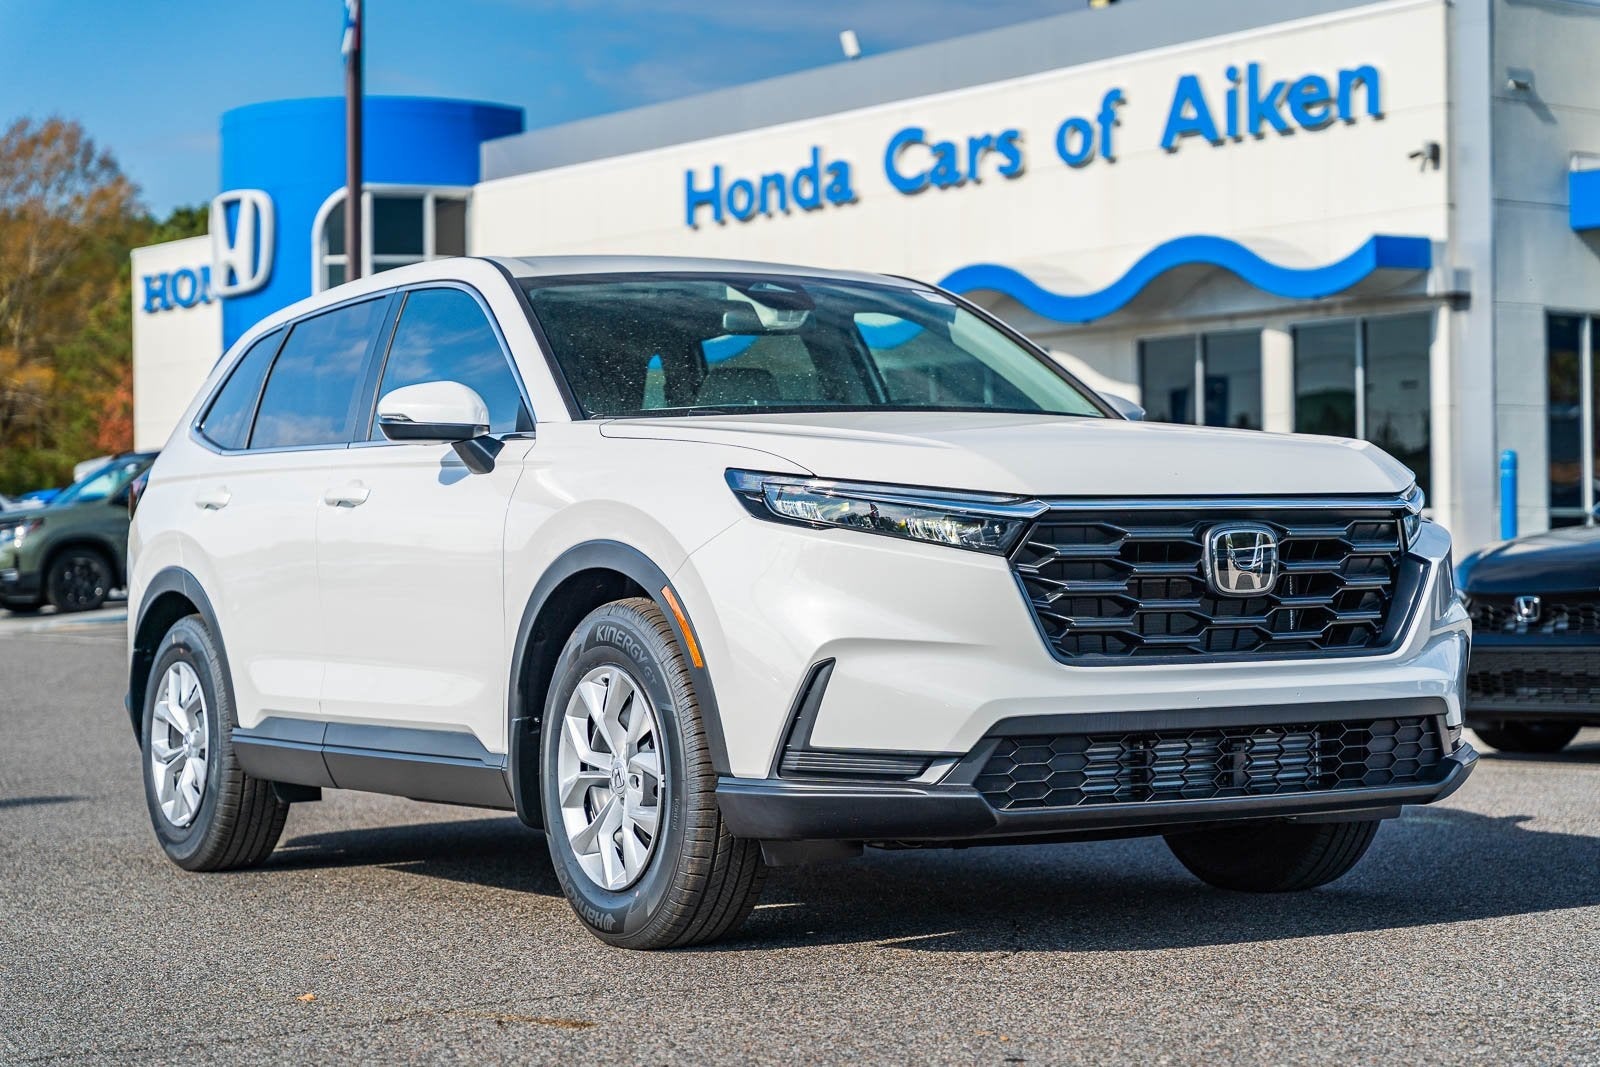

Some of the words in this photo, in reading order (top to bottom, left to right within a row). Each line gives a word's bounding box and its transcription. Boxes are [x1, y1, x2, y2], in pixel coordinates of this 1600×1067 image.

[685, 146, 856, 228] Honda
[883, 126, 1023, 195] Cars
[1055, 87, 1125, 168] of
[1160, 62, 1384, 151] Aiken
[595, 625, 649, 664] KINERGY
